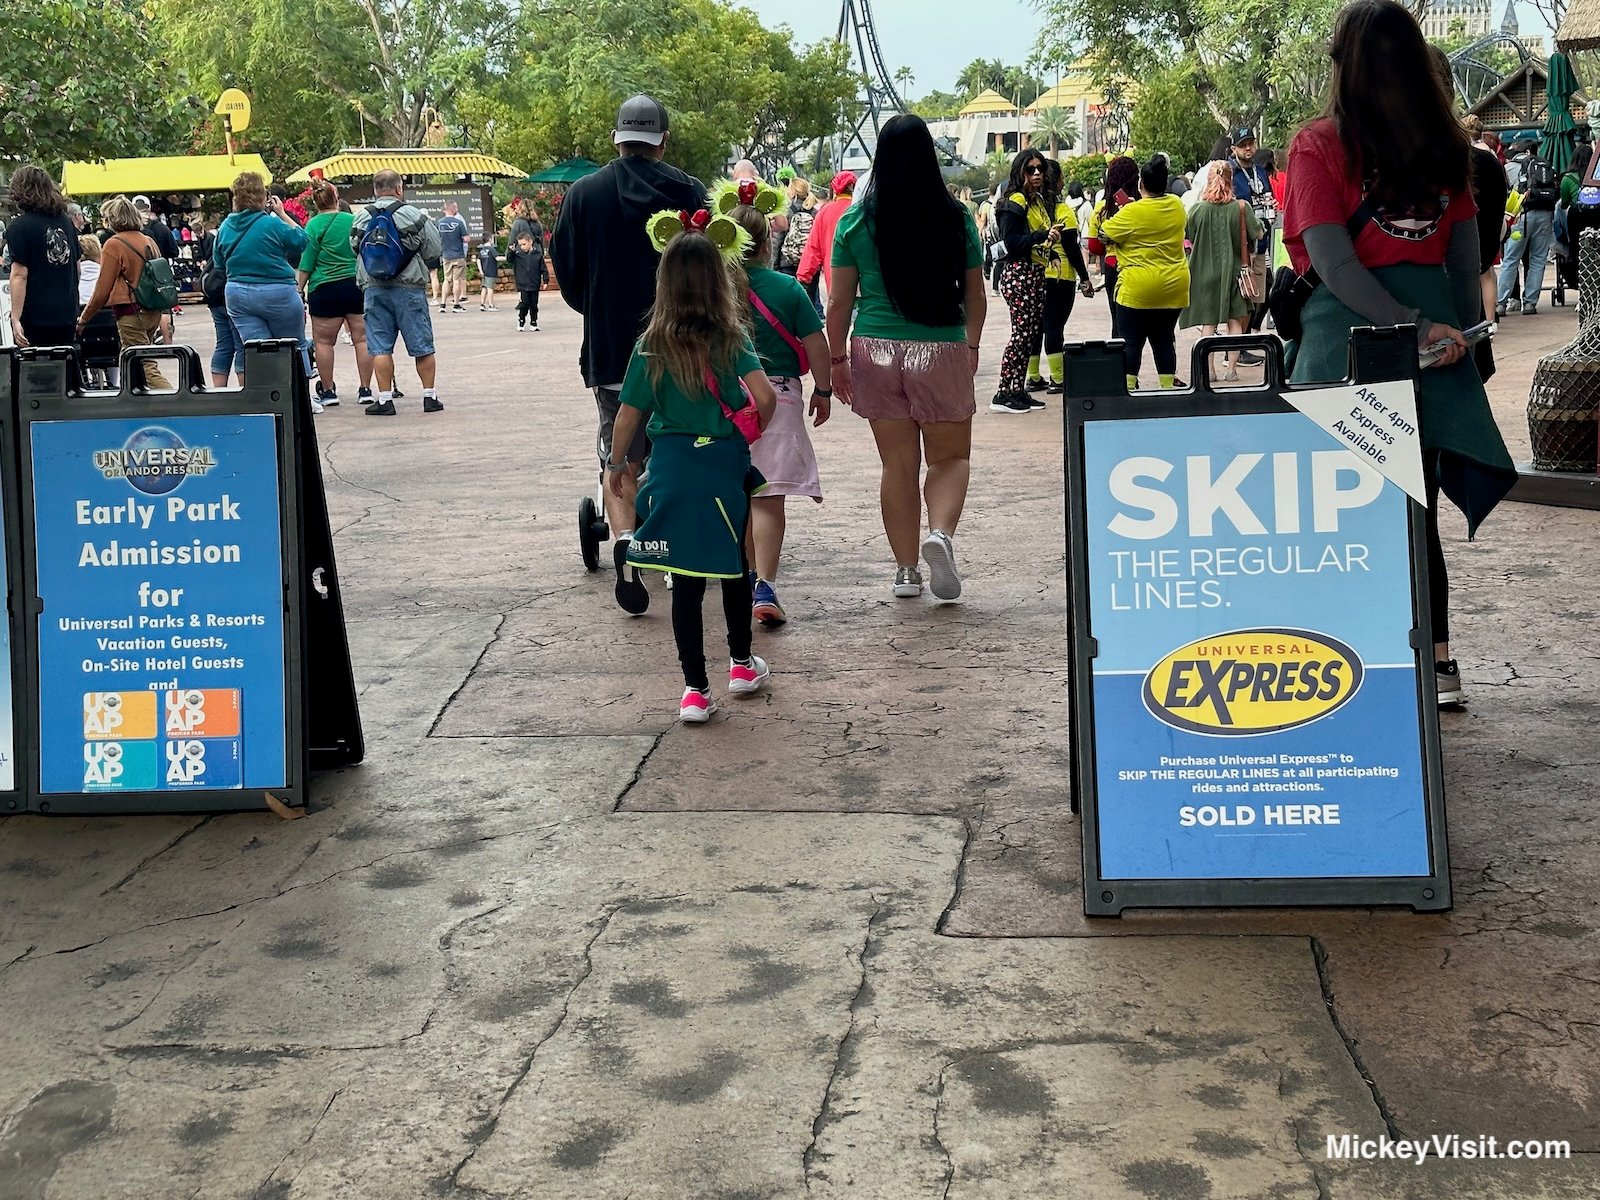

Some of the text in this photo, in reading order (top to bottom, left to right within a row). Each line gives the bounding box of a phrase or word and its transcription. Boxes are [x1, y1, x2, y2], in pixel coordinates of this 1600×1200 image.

[1355, 387, 1415, 436] After 4pm
[1350, 406, 1395, 445] Express
[1332, 420, 1387, 464] Available
[95, 447, 216, 468] UNIVERSAL
[105, 464, 207, 478] ORLANDO RESORT
[1107, 450, 1385, 540] SKIP
[76, 494, 241, 529] Early Park
[78, 539, 241, 567] Admission
[644, 540, 659, 551] DO
[1108, 543, 1370, 579] THE REGULAR
[138, 581, 184, 608] for
[1111, 579, 1231, 610] LINES.
[59, 613, 266, 631] Universal Parks & Resorts
[97, 635, 228, 651] Vacation Guests,
[1197, 644, 1314, 657] UNIVERSAL
[81, 656, 245, 673] On-Site Hotel Guests
[149, 678, 178, 690] and
[1164, 659, 1344, 725] EXPRESS
[1160, 756, 1217, 766] Purchase
[1219, 754, 1277, 765] Universal
[1340, 753, 1354, 763] to
[1118, 766, 1399, 781] SKIP THE REGULAR LINES at all participating
[1192, 781, 1324, 793] rides and attractions.
[1179, 804, 1341, 827] SOLD HERE
